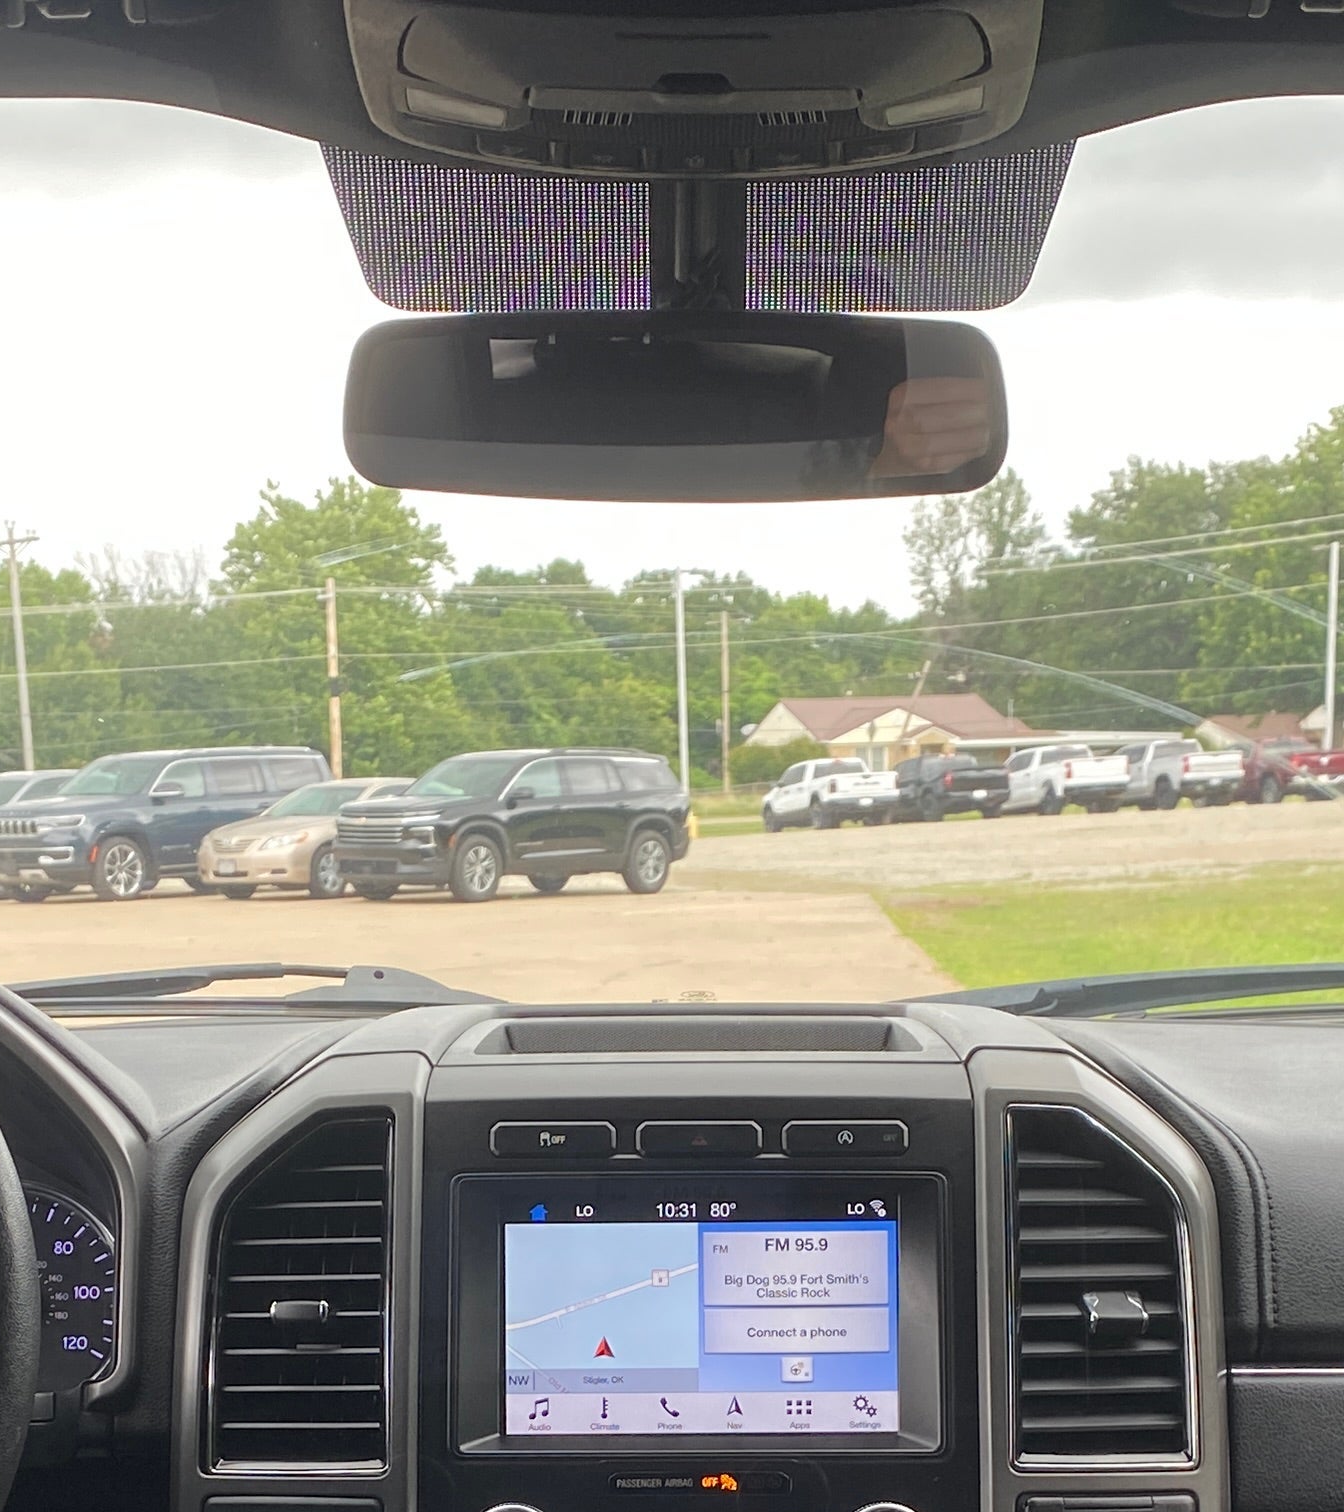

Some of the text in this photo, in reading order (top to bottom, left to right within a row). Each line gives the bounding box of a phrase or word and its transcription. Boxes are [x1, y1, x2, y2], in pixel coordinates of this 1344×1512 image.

[551, 1135, 566, 1144] OFF
[575, 1205, 594, 1217] LO
[656, 1202, 737, 1218] 10:31 80°
[847, 1203, 865, 1215] LO
[53, 1240, 74, 1255] 80
[713, 1245, 729, 1254] FM
[765, 1238, 828, 1252] FM 95.9
[724, 1273, 869, 1287] Big Dog 95.9 Fort Smith's
[73, 1285, 100, 1300] 100
[756, 1287, 830, 1298] Classic Rock
[747, 1326, 847, 1340] Connect a phone
[62, 1336, 88, 1350] 120
[508, 1375, 530, 1386] NW
[611, 1375, 624, 1384] OK
[528, 1423, 552, 1431] Audio
[590, 1422, 620, 1431] Climate
[657, 1422, 683, 1431] Phone
[789, 1421, 810, 1430] Apps
[849, 1420, 881, 1430] Settings
[616, 1476, 719, 1488] PASSENGER AIRBAG OFF
